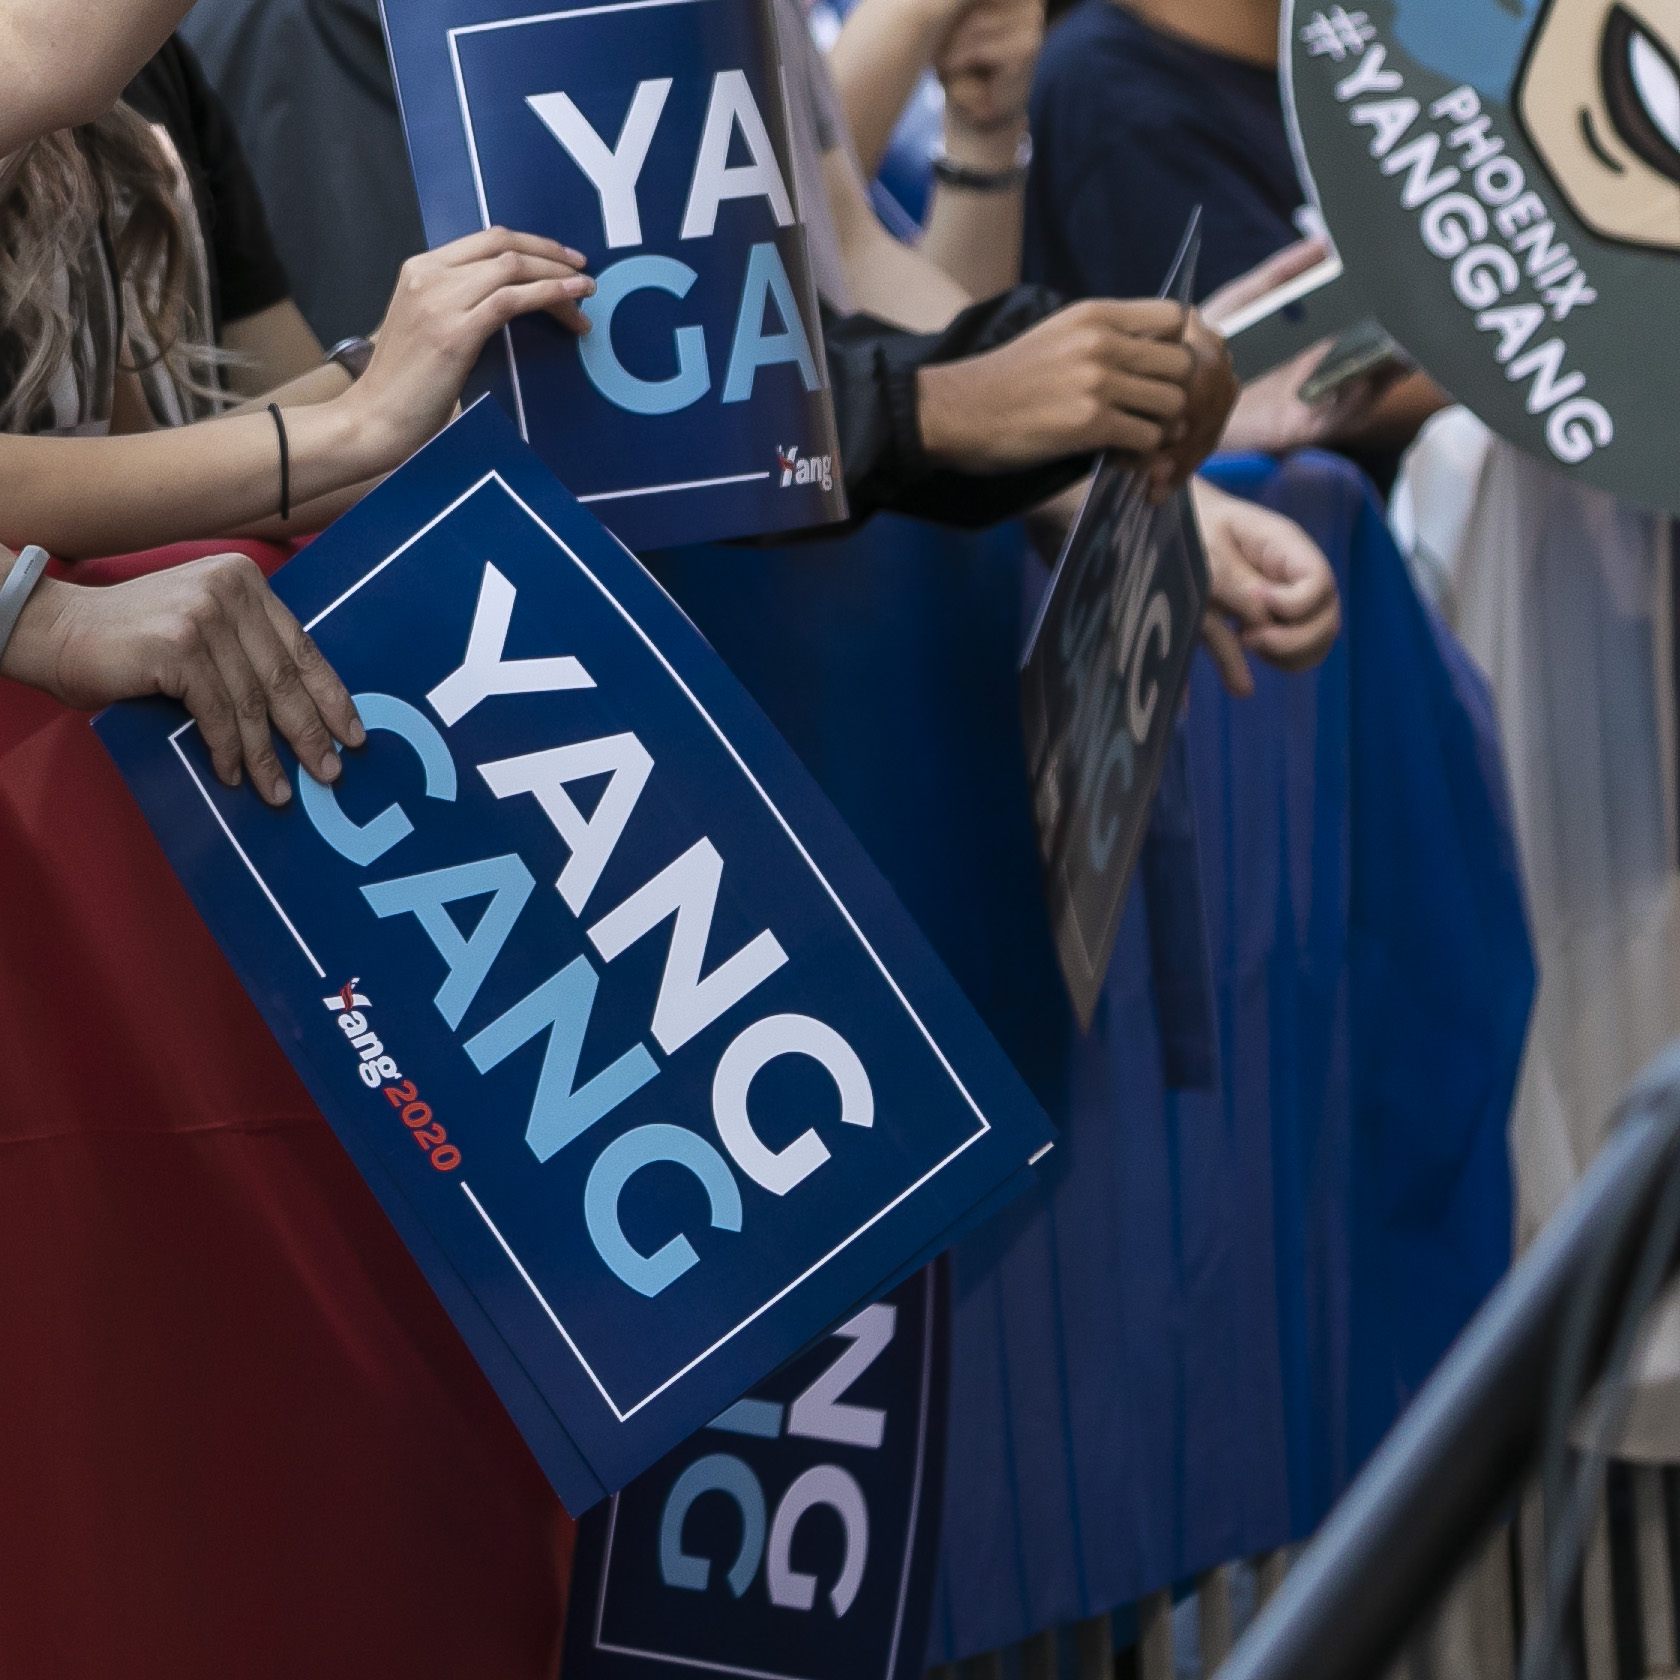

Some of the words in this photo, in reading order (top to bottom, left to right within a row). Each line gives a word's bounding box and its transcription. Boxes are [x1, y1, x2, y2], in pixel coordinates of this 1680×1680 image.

[1299, 3, 1615, 465] #YANGGANG
[1428, 83, 1599, 321] PHOENIX
[776, 444, 842, 492] Yang
[297, 691, 745, 1298] GANG
[426, 560, 875, 1197] YANG
[322, 977, 462, 1172] Yang2020
